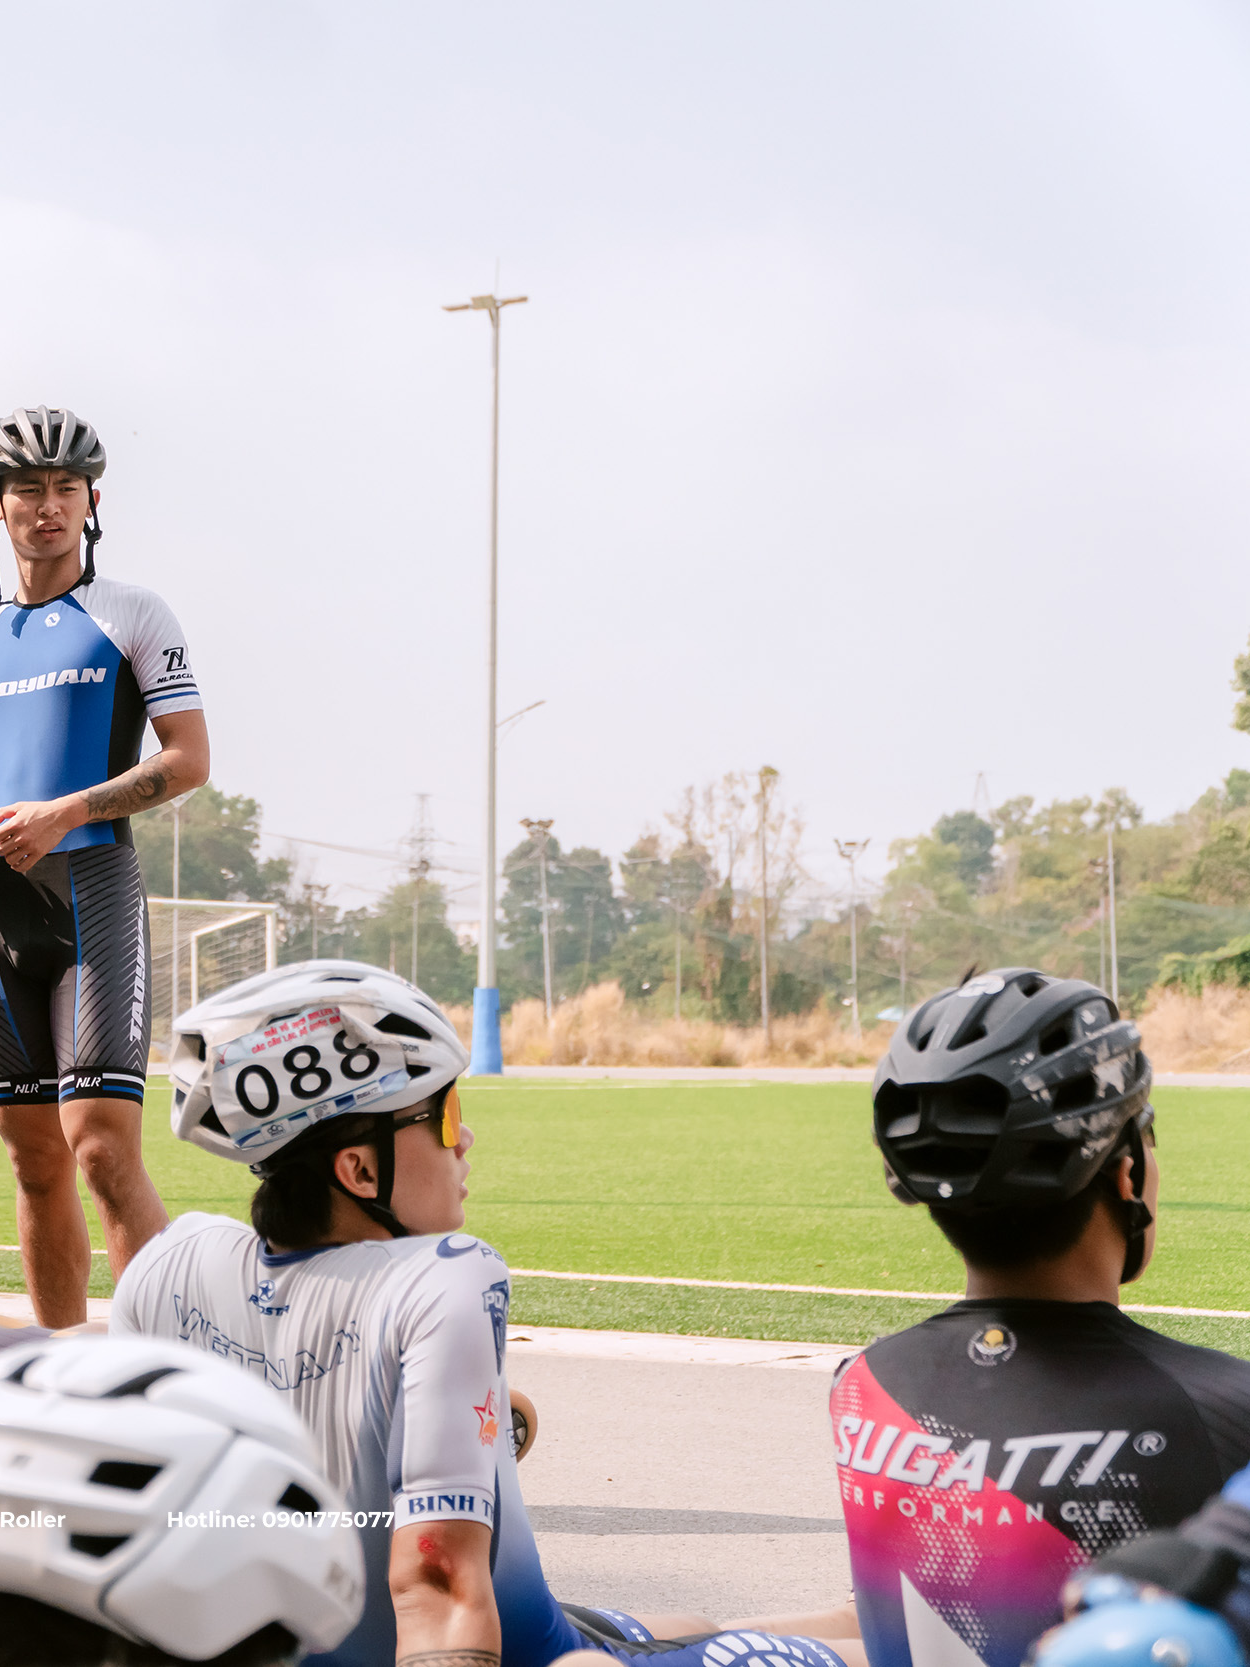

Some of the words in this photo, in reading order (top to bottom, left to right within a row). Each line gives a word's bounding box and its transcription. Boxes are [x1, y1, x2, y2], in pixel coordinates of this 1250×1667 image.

[14, 1083, 39, 1094] NLR
[76, 1076, 102, 1089] NLR
[235, 1029, 380, 1119] 088
[836, 1414, 1130, 1492] SUGATTI
[408, 1494, 475, 1516] BINH
[840, 1480, 1118, 1525] ERFORMANCE
